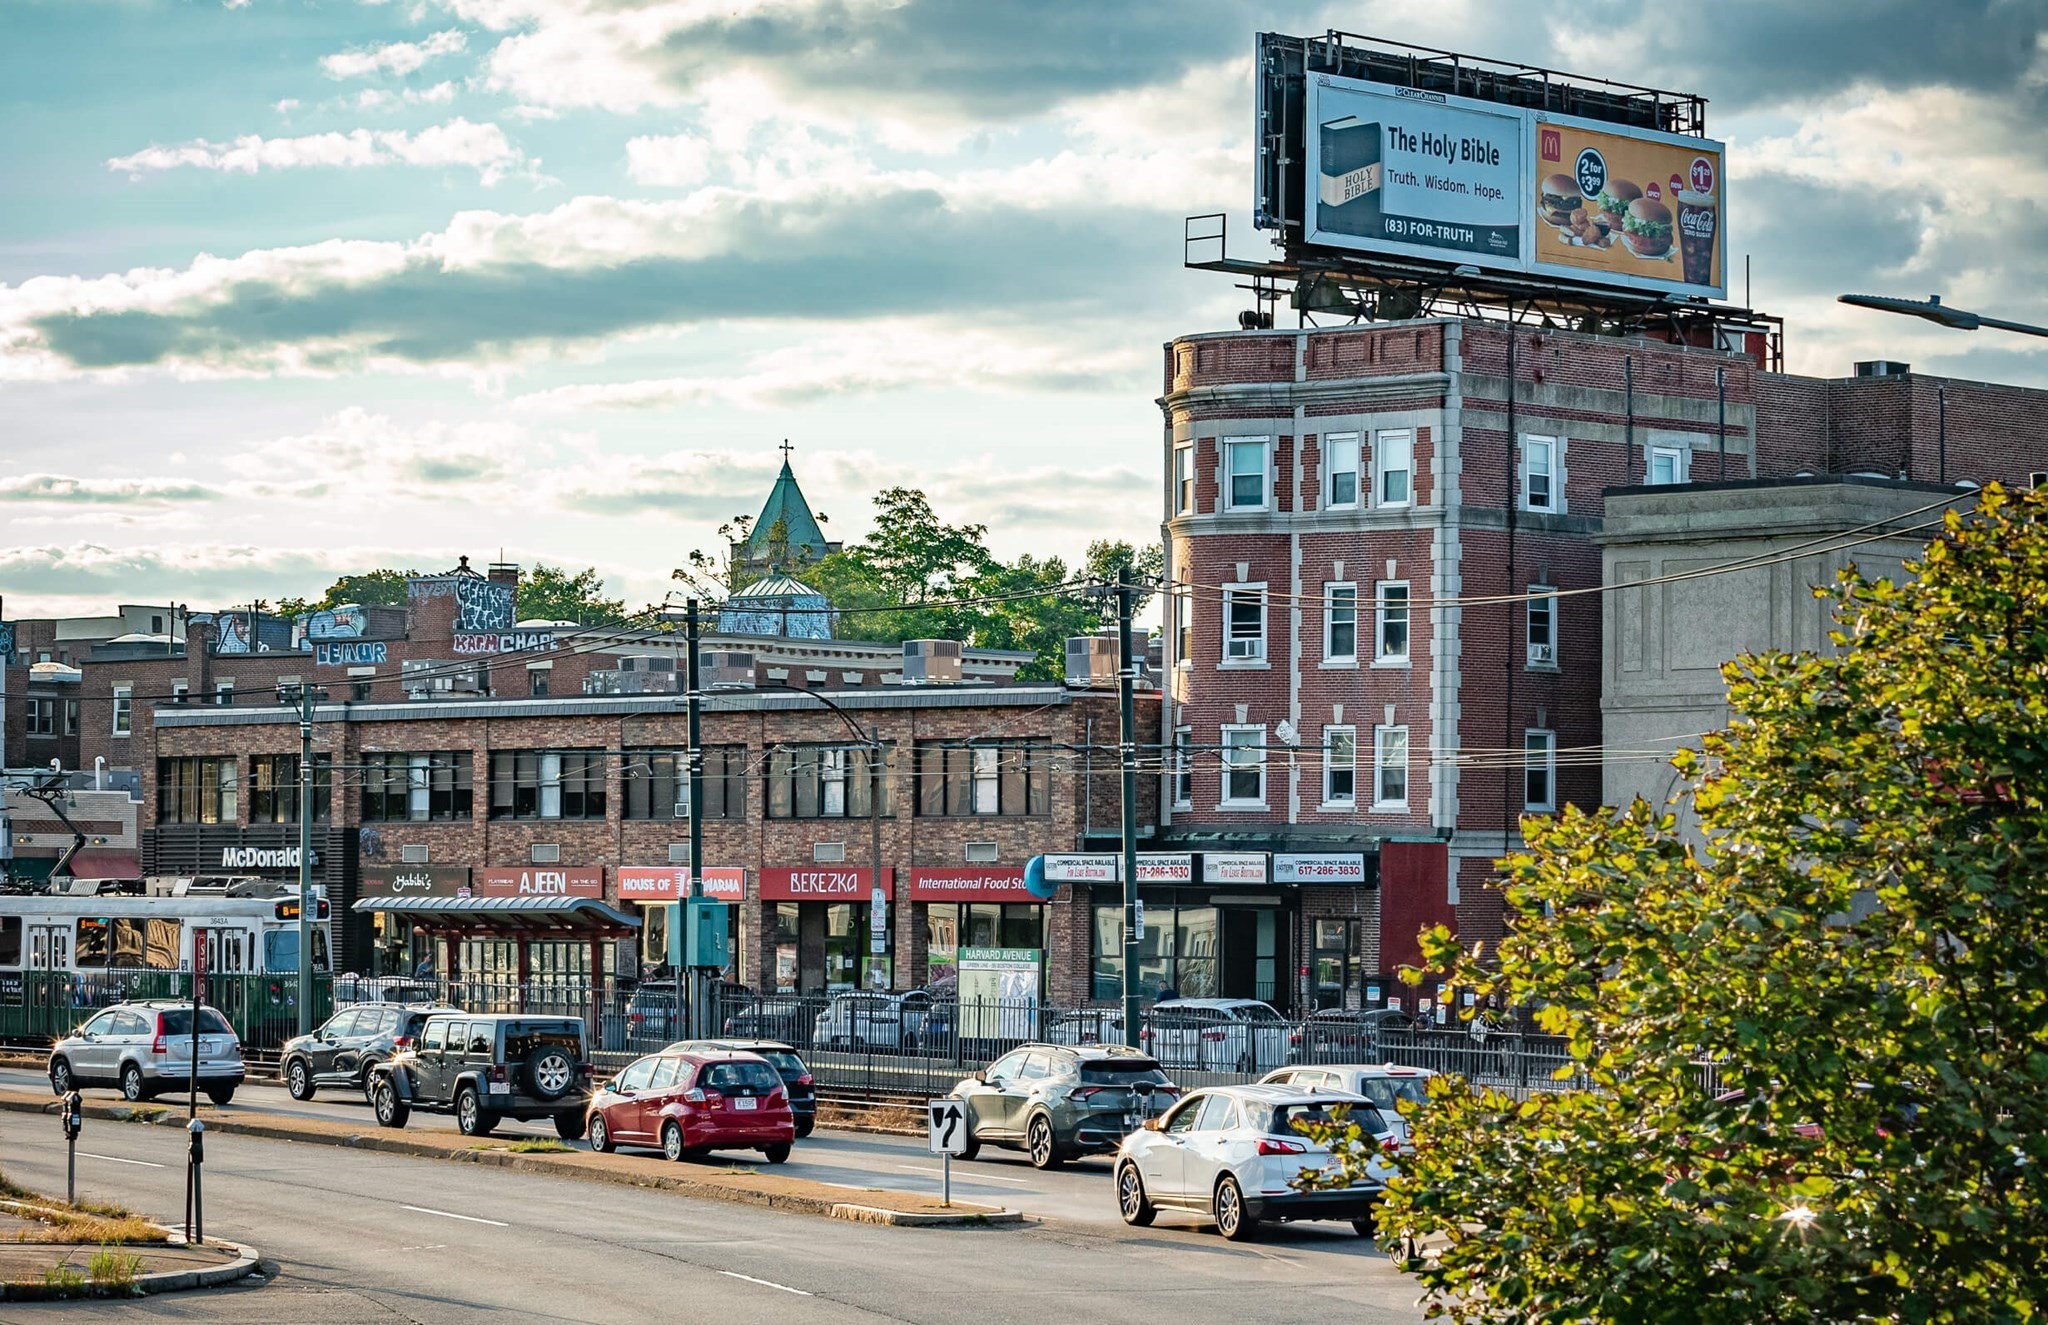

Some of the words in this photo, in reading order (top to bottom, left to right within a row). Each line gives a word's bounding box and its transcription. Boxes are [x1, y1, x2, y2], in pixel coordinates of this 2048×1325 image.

[1388, 126, 1417, 153] The
[1422, 131, 1457, 164] Holy
[1461, 138, 1500, 166] Bible
[1581, 158, 1589, 175] 2
[1590, 161, 1602, 174] for
[1345, 167, 1373, 187] HOLY
[1388, 169, 1420, 187] Truth.
[1425, 175, 1470, 195] Wisdom.
[1474, 182, 1505, 201] Hope.
[1344, 179, 1373, 201] BIBLE
[1385, 217, 1407, 236] (83)
[1410, 221, 1474, 243] FOR-TRUTH
[317, 641, 386, 665] LEMUR
[222, 847, 318, 867] McDonald
[1298, 866, 1360, 876] 617-286-3830
[392, 872, 432, 892] Habibi's
[519, 871, 566, 894] AJEEN
[622, 878, 655, 891] HOUSE
[657, 878, 671, 891] OF
[686, 878, 740, 892] SWARMA
[790, 872, 858, 893] BEREZKA
[918, 876, 982, 889] International
[983, 876, 1010, 889] Food
[1011, 877, 1027, 889] Sto
[965, 949, 1000, 960] HARVARD
[1001, 950, 1032, 961] AVENUE
